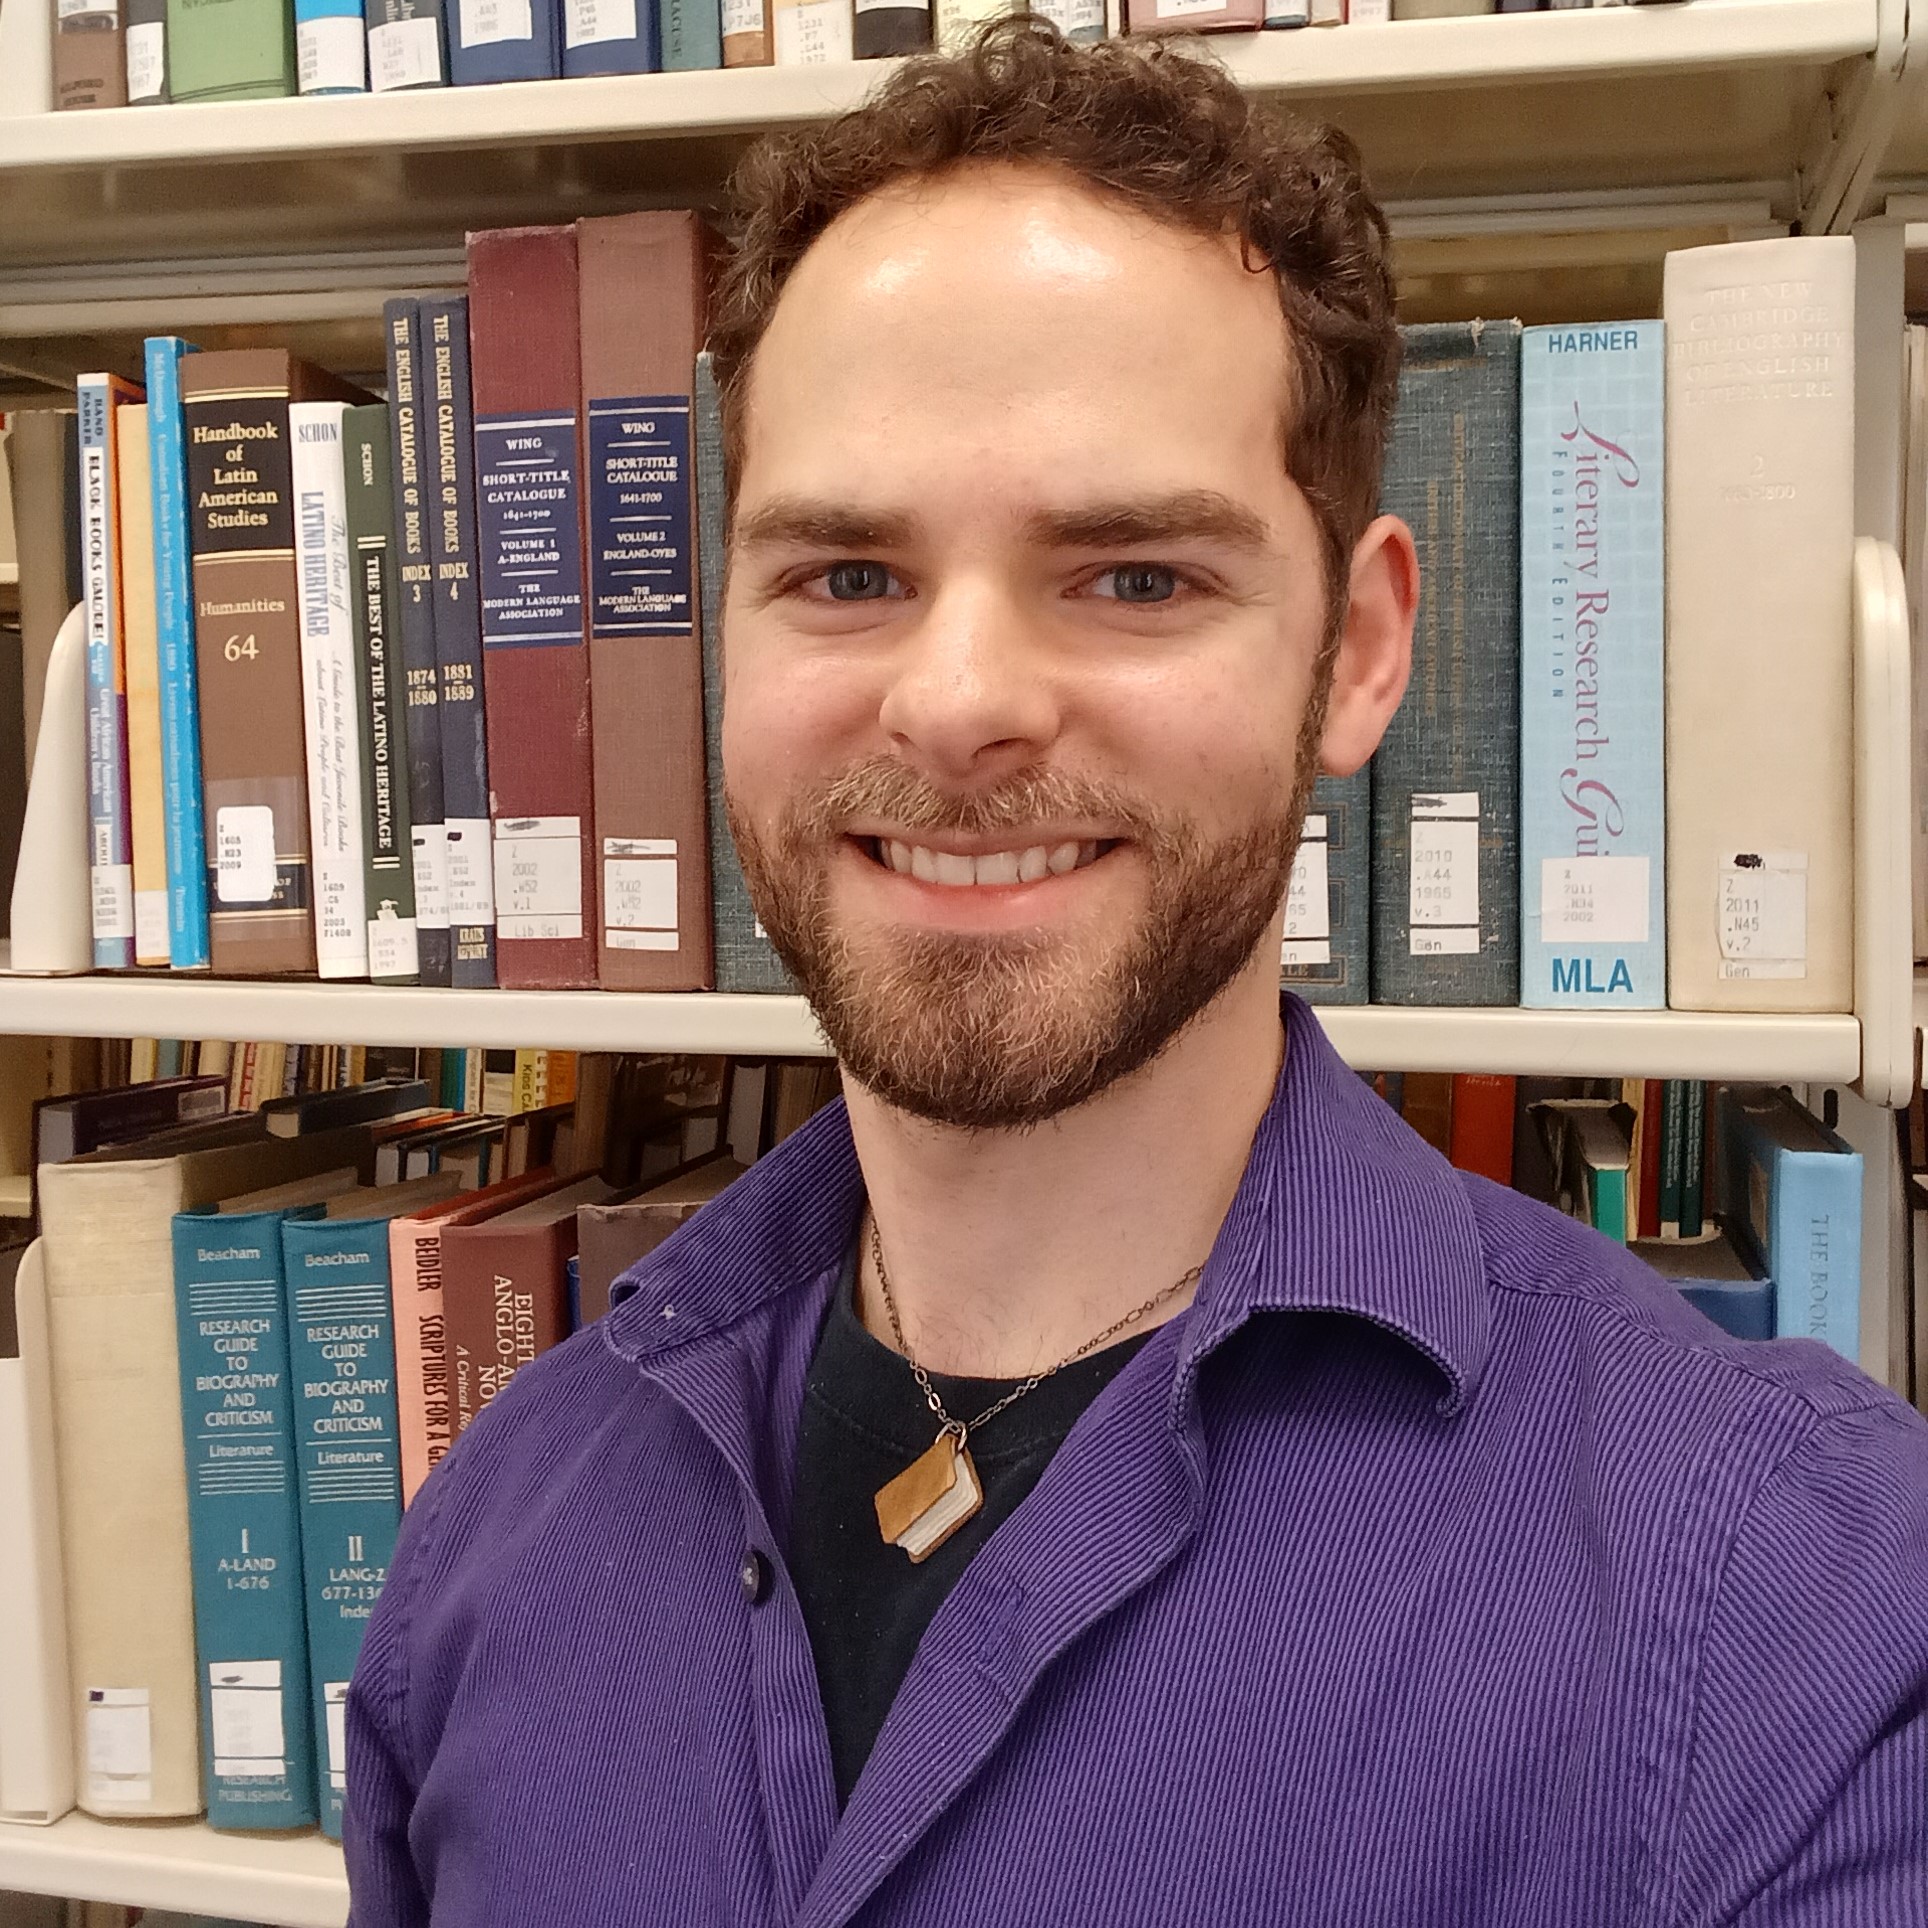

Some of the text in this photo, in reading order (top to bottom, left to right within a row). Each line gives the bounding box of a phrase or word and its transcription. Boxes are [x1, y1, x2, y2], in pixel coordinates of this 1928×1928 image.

[1548, 331, 1639, 354] HARNER
[1684, 380, 1833, 406] LITERATURE
[192, 421, 279, 444] Handbook
[299, 422, 338, 443] SCHON
[394, 318, 422, 555] THE ENGLISH CATALOGUE OF BOOKS
[433, 315, 460, 553] THE ENGLISH CATALOGUE OF BOOKS
[621, 421, 656, 435] WING
[505, 437, 544, 451] WING
[224, 443, 244, 463] of
[360, 442, 375, 487] SCHON
[605, 455, 679, 471] SHORT-TITLE
[1749, 455, 1765, 479] 2
[88, 455, 103, 510] BLACK
[212, 467, 258, 486] Latin
[482, 470, 571, 487] SHORT-TITLE
[606, 470, 679, 484] CATALOGUE
[487, 488, 568, 504] CATALOGUE
[1560, 400, 1641, 579] Literary
[197, 489, 279, 508] American
[619, 492, 664, 505] 1641-1700
[206, 509, 269, 530] Studies
[502, 509, 552, 521] 1641-1700
[330, 514, 347, 546] The
[616, 531, 667, 544] VOLUME 2
[90, 516, 106, 571] BOOKS
[500, 538, 557, 551] VOLUME 1
[497, 551, 561, 565] A-ENGLAND
[602, 547, 678, 561] ENGLAND-OYES
[301, 490, 330, 638] LATINO HERITAGE
[332, 551, 348, 590] Best
[439, 561, 470, 580] INDEX
[401, 564, 431, 582] INDEX
[1552, 450, 1569, 699] FOURTH EDITION
[413, 583, 422, 603] 3
[450, 581, 459, 601] 4
[518, 583, 542, 595] THE
[630, 585, 651, 596] THE
[200, 600, 286, 617] Humanities
[482, 595, 582, 610] MODERN LANGUAGE
[598, 593, 688, 607] MODERN LANGUAGE
[612, 601, 673, 614] ASSOCIATION
[498, 607, 565, 620] ASSOCIATION
[223, 634, 260, 662] 64
[407, 669, 437, 687] 1874
[444, 664, 473, 681] 1881
[1575, 588, 1611, 763] Research
[408, 690, 438, 707] 1880
[444, 684, 475, 701] 1889
[366, 556, 393, 849] THE BEST OF THE LATINO HERITAGE
[1414, 849, 1453, 863] 2010
[512, 863, 538, 876] 2002
[1416, 868, 1452, 882] .A44
[615, 880, 642, 893] 2002
[1414, 887, 1453, 900] 1965
[1563, 884, 1594, 895] 2011
[1726, 878, 1735, 894] Z
[1414, 905, 1443, 918] v.3
[1726, 898, 1759, 914] 2011
[1562, 912, 1595, 922] 2002
[1727, 917, 1759, 932] .N45
[1414, 938, 1443, 952] Gen
[1726, 936, 1751, 951] v.2
[1552, 957, 1634, 993] MLA
[1725, 963, 1750, 978] Gen
[1810, 1213, 1830, 1263] THE
[197, 1246, 261, 1263] Beacham
[304, 1251, 371, 1268] Beacham
[199, 1318, 271, 1337] RESEARCH
[306, 1323, 380, 1343] RESEARCH
[213, 1335, 259, 1354] GUIDE
[414, 1236, 451, 1448] BEIDLER SCRIPTURES FOR A
[321, 1342, 369, 1361] GUIDE
[225, 1355, 249, 1371] TO
[334, 1361, 358, 1378] TO
[196, 1373, 280, 1392] BIOGRAPHY
[456, 1344, 472, 1408] A Critical
[304, 1378, 390, 1399] BIOGRAPHY
[223, 1391, 257, 1408] AND
[331, 1398, 367, 1415] AND
[204, 1410, 275, 1428] CRITICISM
[313, 1415, 384, 1434] CRITICISM
[208, 1443, 275, 1459] Literature
[317, 1449, 386, 1466] Literature
[347, 1535, 365, 1562] II
[217, 1557, 277, 1573] A-LAND
[226, 1574, 271, 1591] 1-676
[329, 1566, 386, 1582] LANG-Z
